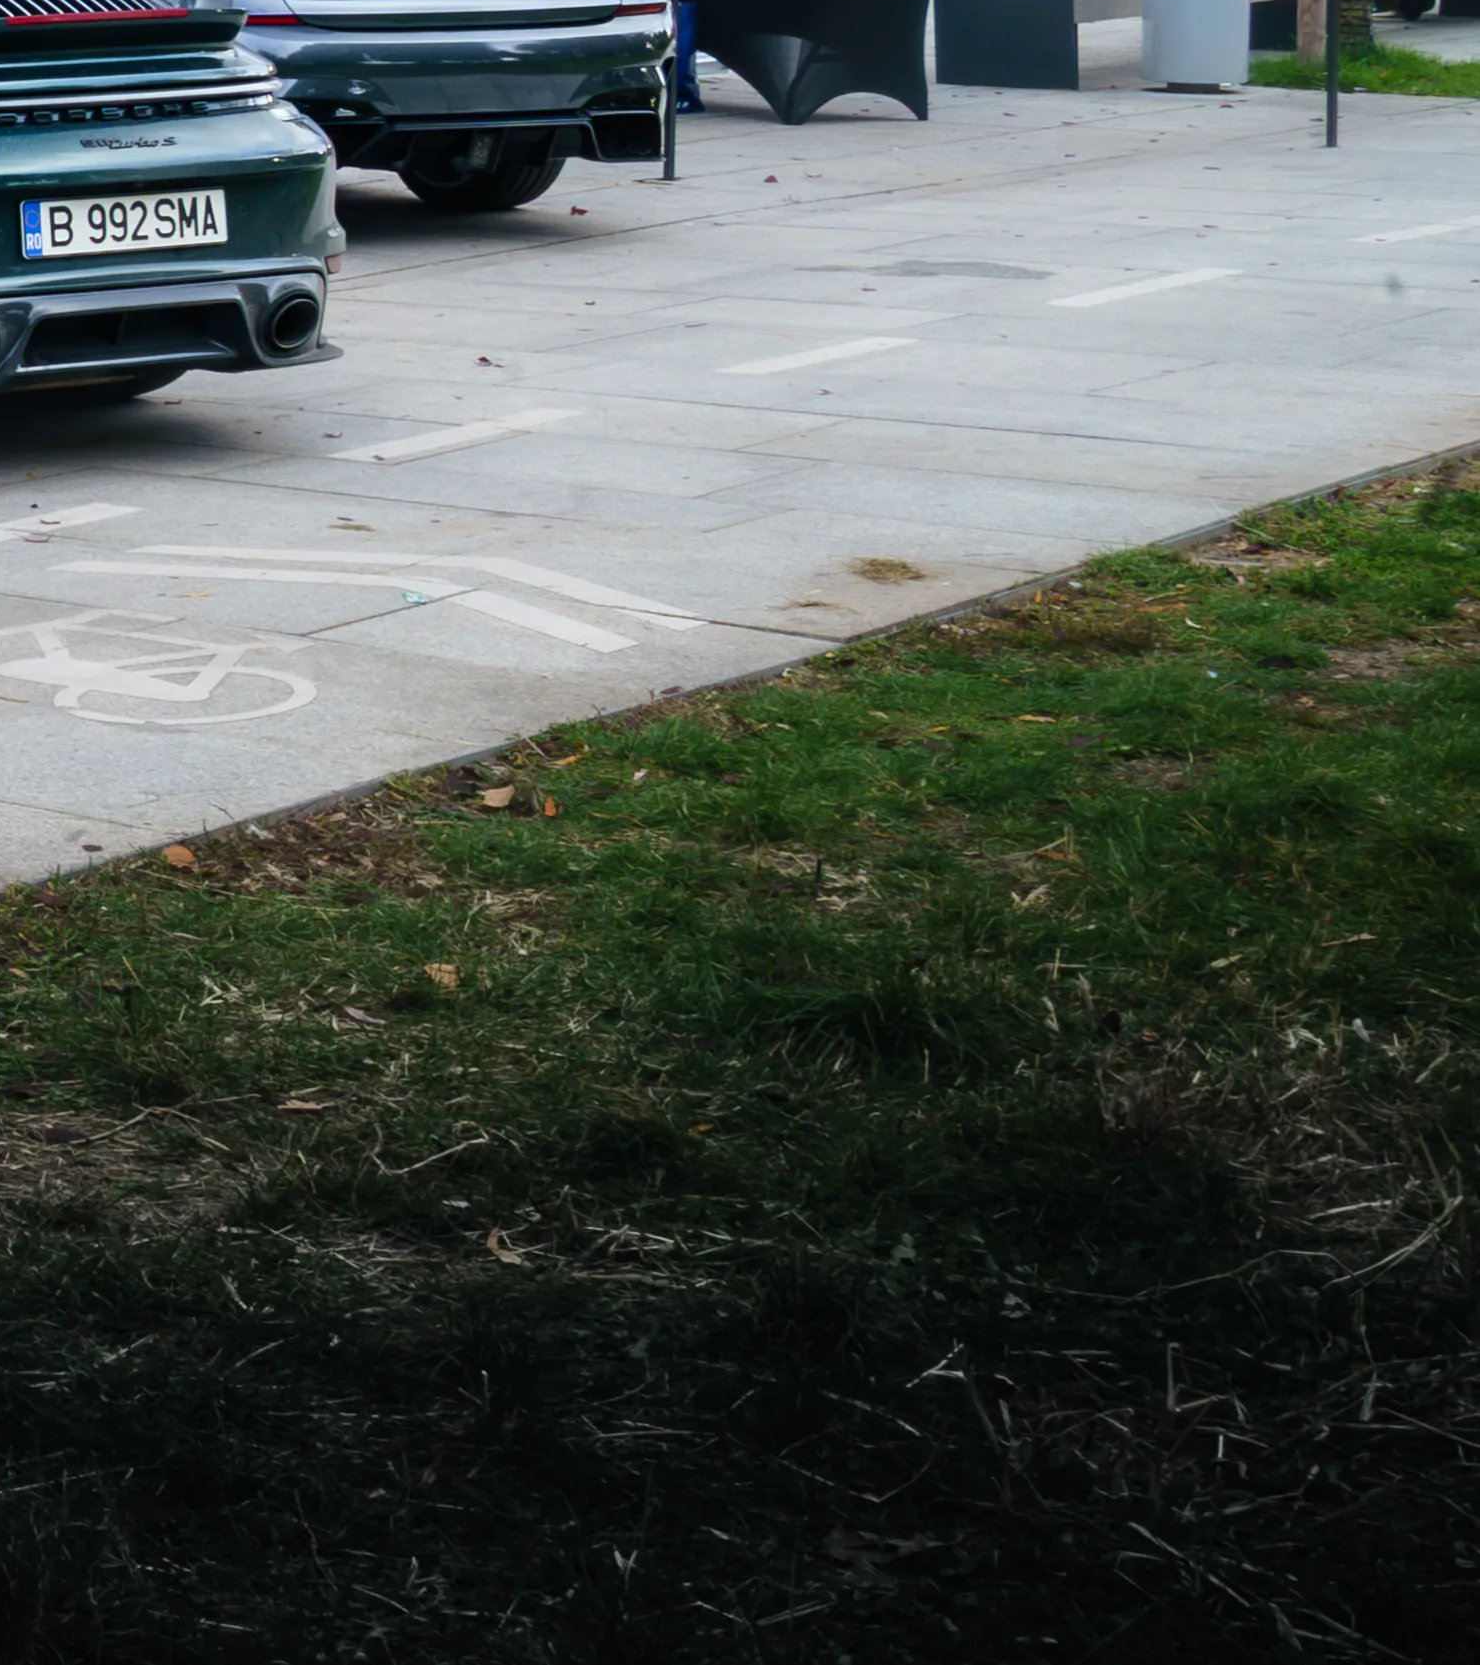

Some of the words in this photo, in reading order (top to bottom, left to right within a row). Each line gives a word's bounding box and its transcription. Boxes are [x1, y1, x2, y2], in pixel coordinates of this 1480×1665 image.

[161, 137, 176, 146] S
[26, 232, 43, 250] RO
[48, 205, 74, 247] B
[87, 194, 219, 244] 992SMA
